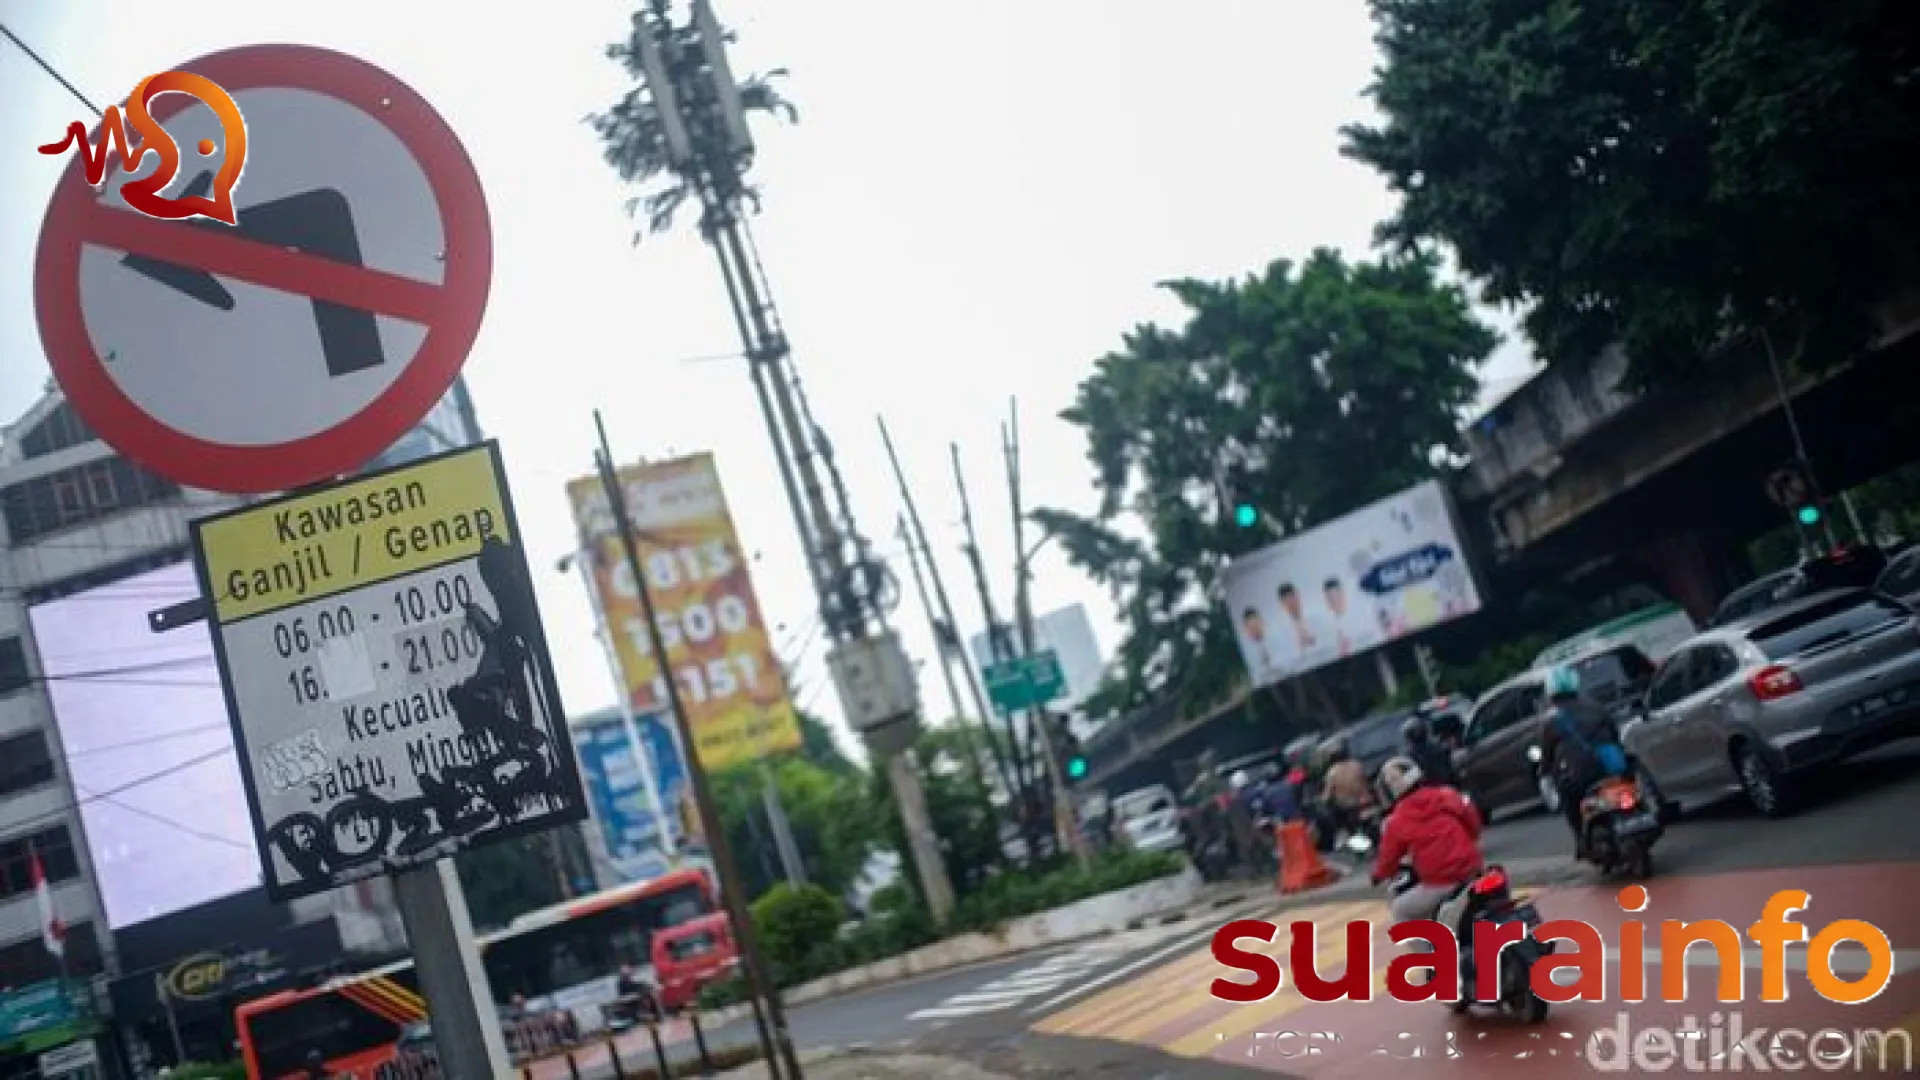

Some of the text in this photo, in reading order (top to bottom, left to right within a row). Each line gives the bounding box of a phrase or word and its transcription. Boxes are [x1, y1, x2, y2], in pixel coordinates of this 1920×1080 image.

[273, 480, 427, 543] Kawasan
[227, 507, 495, 602] Ganjil / Genap
[273, 604, 356, 659] 06.00
[394, 574, 473, 626] 10.00
[403, 622, 480, 676] 21.00
[342, 687, 449, 743] Kecuali
[405, 730, 500, 780] Ming
